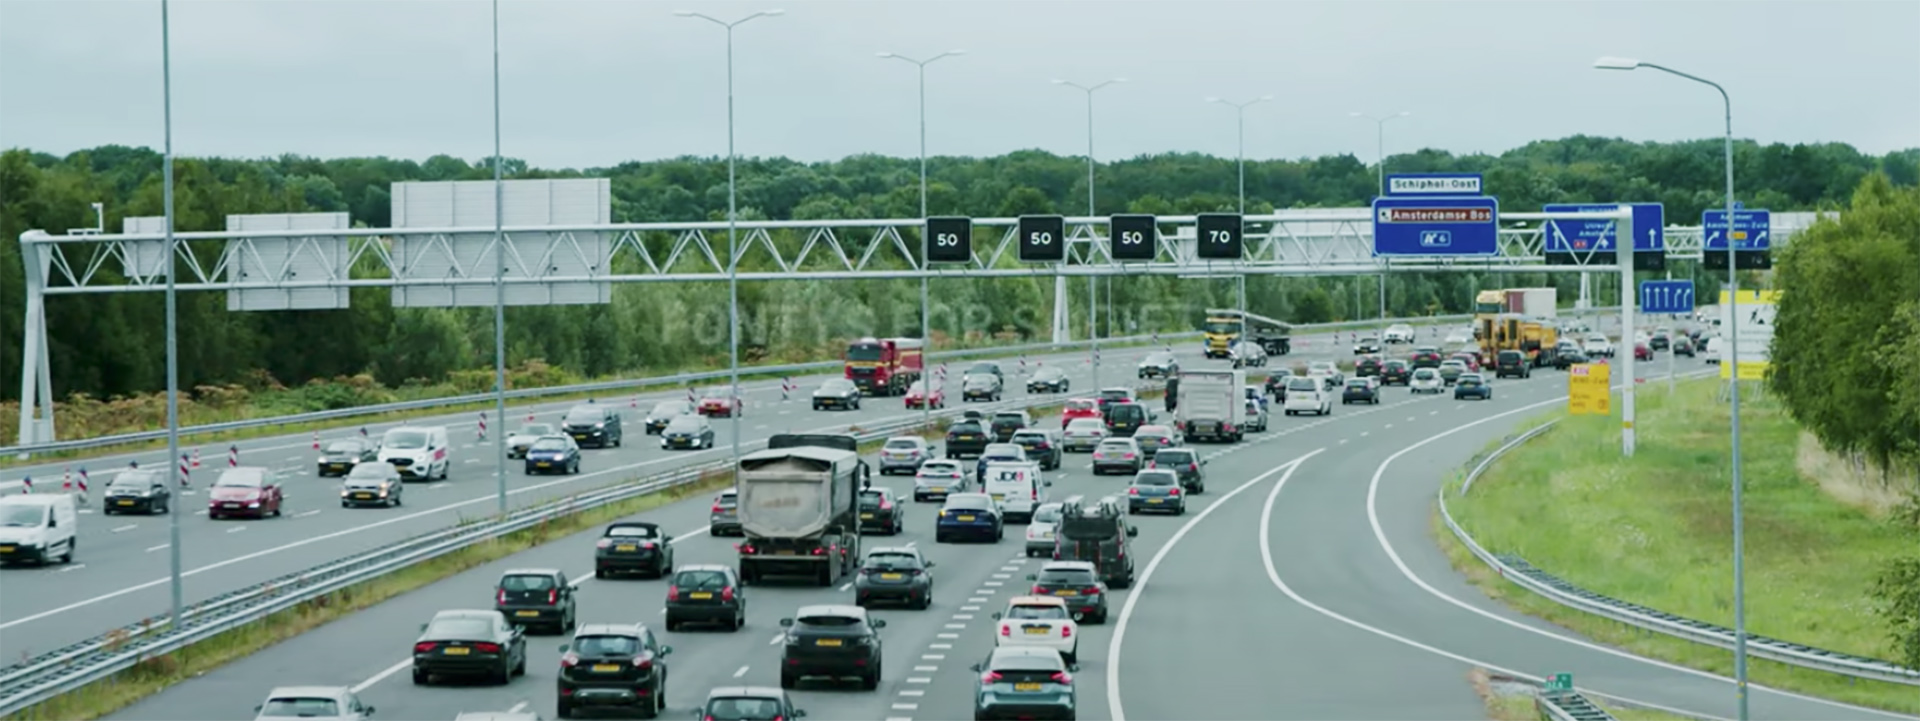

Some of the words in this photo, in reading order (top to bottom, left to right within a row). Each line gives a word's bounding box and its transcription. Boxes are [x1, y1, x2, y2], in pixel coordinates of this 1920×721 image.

[1395, 180, 1477, 190] Schiphol-Oost
[1393, 210, 1467, 220] Amsterdamse
[1469, 210, 1491, 220] Bos
[937, 234, 958, 247] 50
[1031, 232, 1052, 245] 50
[1121, 232, 1143, 245] 50
[1209, 231, 1230, 244] 70
